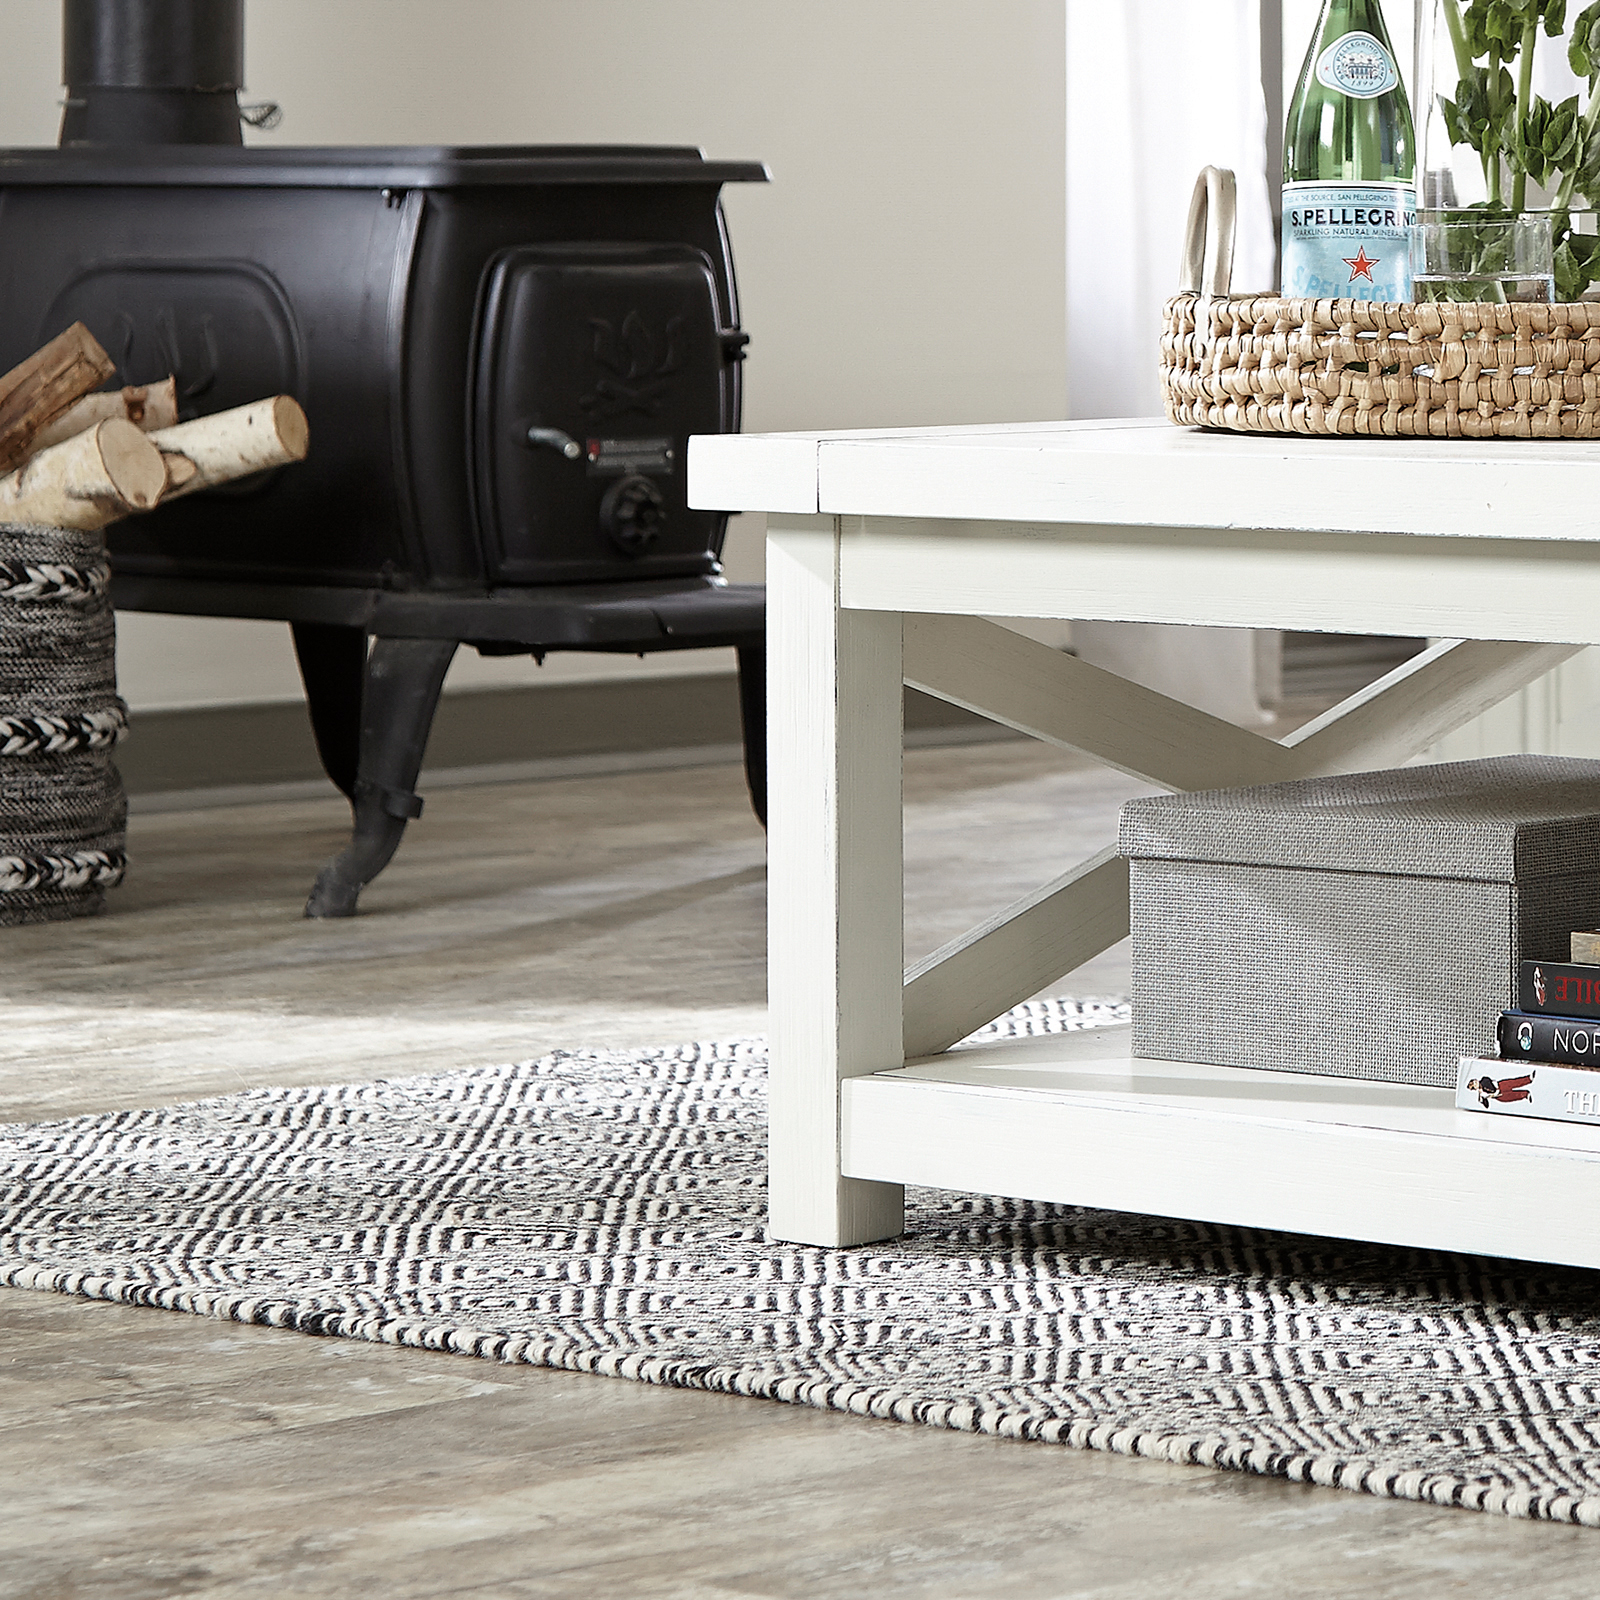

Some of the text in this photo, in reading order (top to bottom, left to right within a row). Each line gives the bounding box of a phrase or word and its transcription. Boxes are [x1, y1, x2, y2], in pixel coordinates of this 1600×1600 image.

[1337, 193, 1352, 201] SAN
[1353, 193, 1388, 202] PELLEGRINO
[1293, 228, 1330, 237] SPARKLING
[1332, 227, 1370, 236] NATURAL
